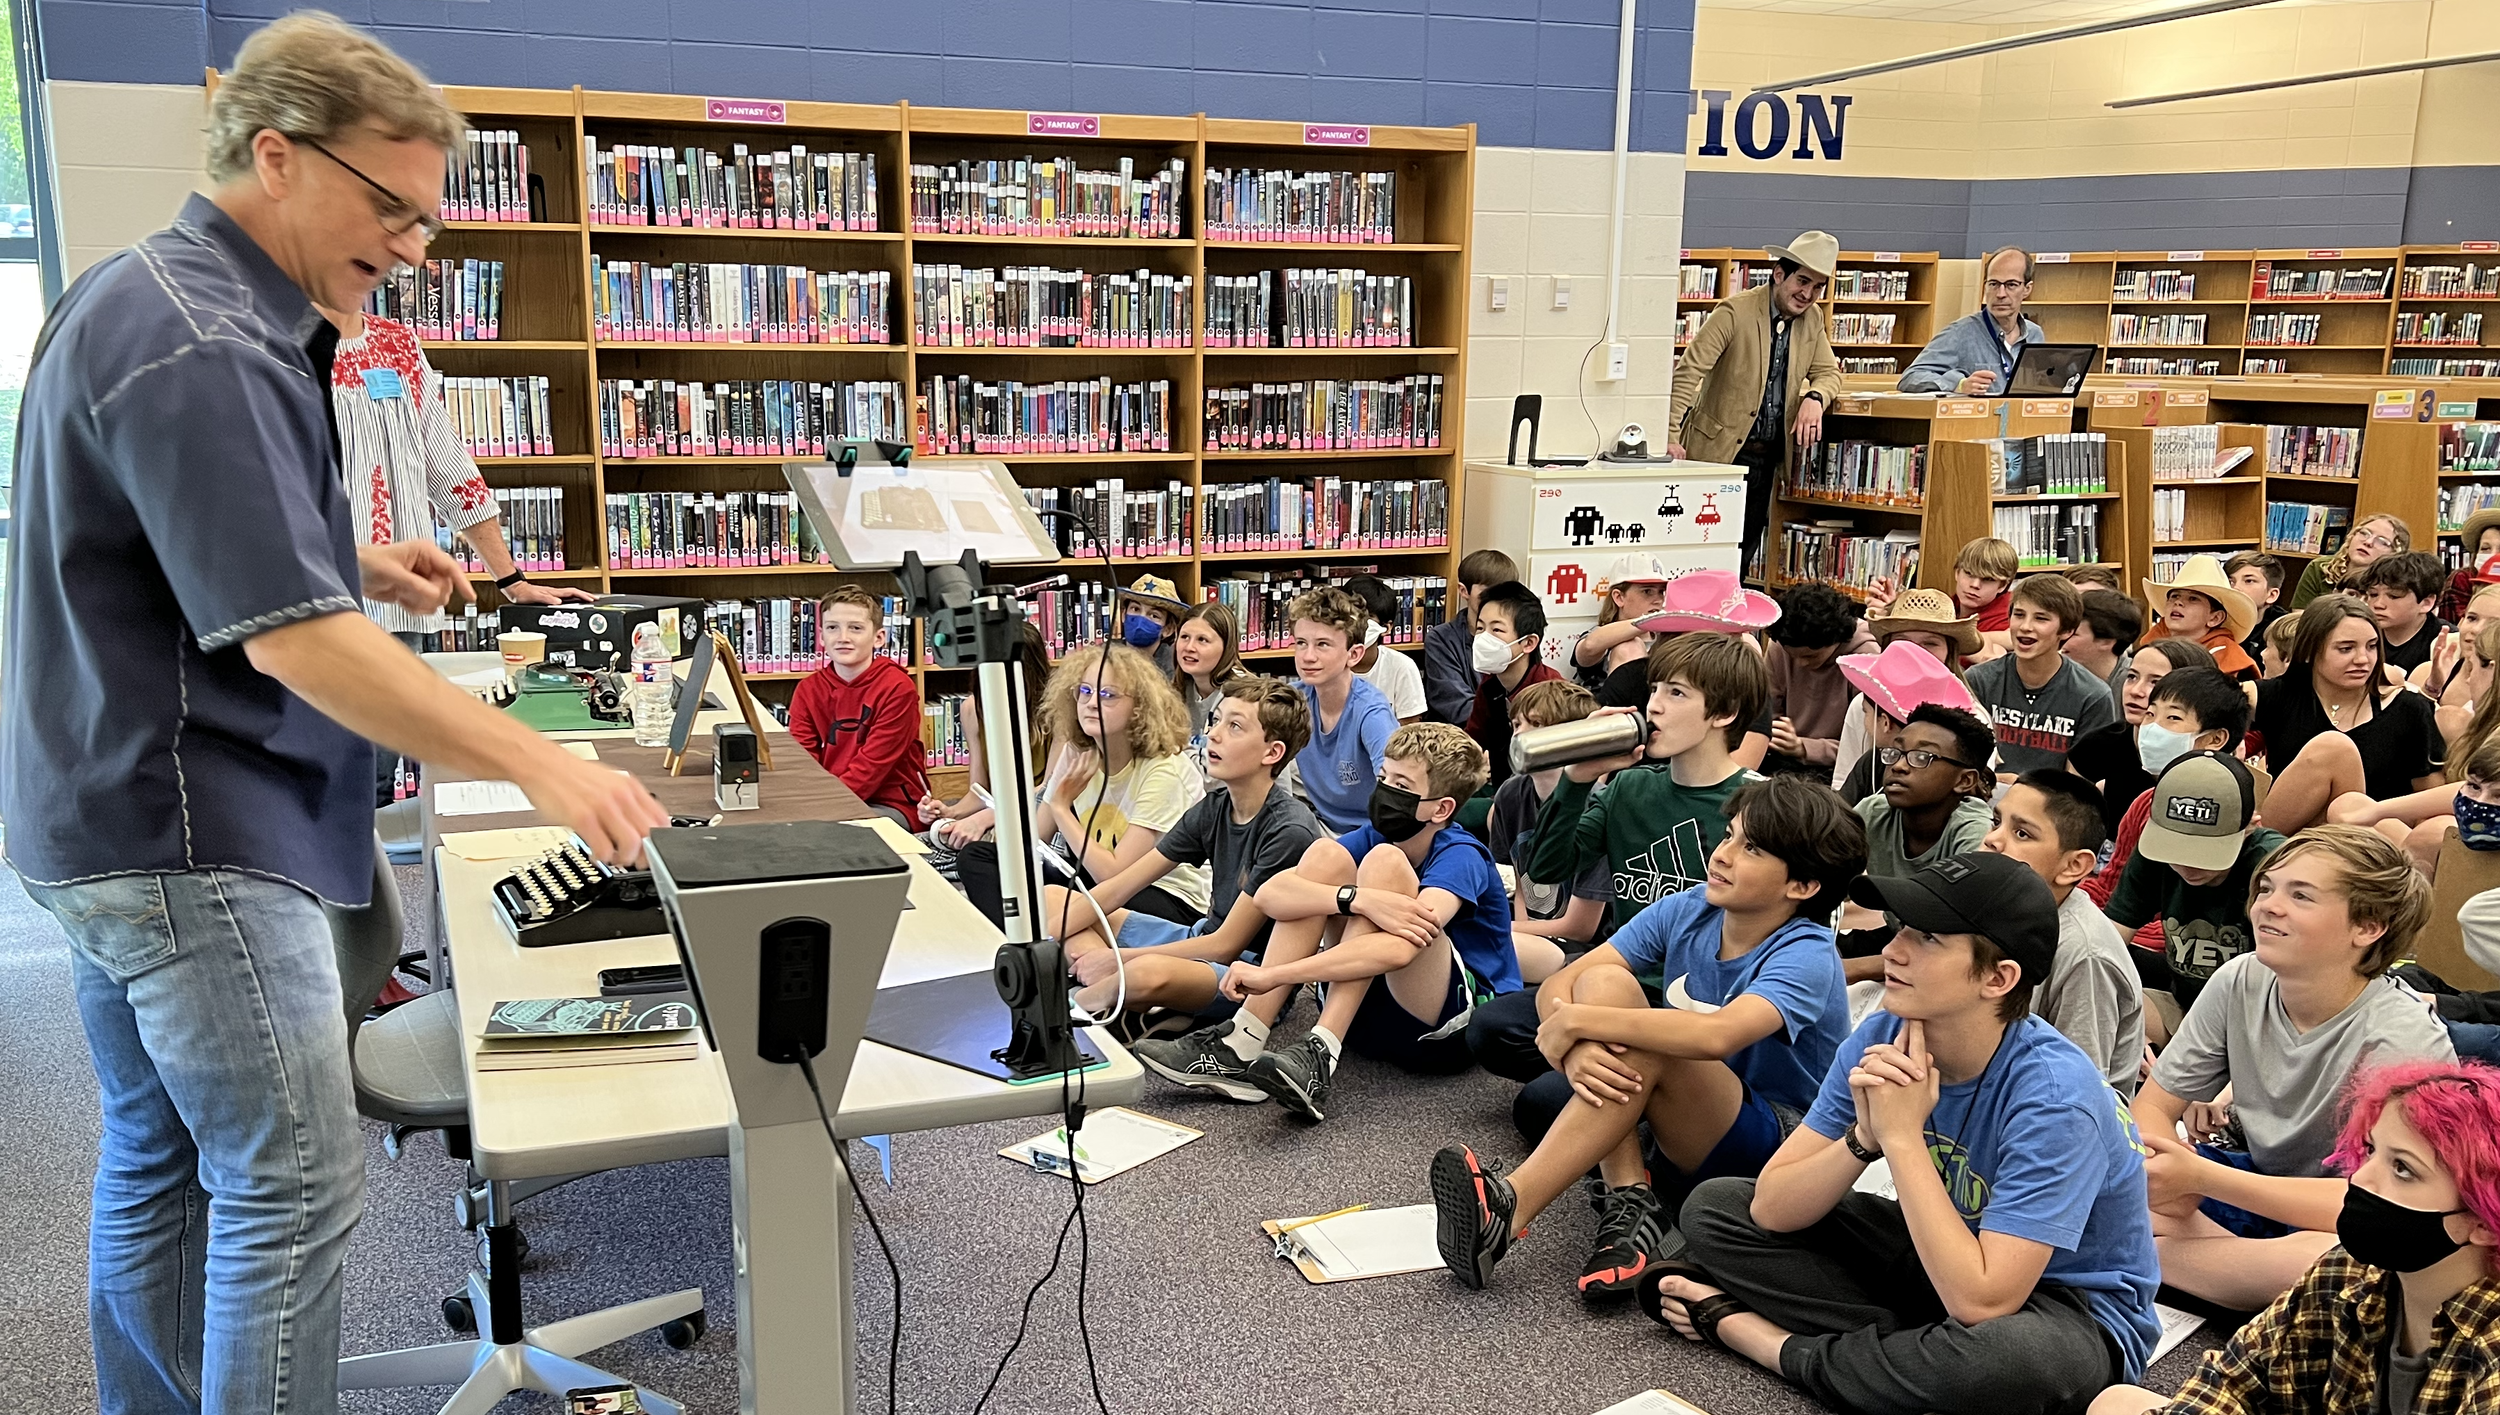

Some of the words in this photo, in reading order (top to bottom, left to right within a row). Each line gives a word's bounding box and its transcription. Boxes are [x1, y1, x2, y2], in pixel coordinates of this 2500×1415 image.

[728, 107, 765, 116] FANTASY
[1047, 121, 1080, 129] FANTASY
[1689, 90, 1852, 160] ION
[1321, 131, 1352, 139] FANTASY
[1994, 401, 2009, 437] 1
[2143, 390, 2161, 425] 2
[2418, 389, 2435, 422] 3
[1539, 488, 1562, 498] 290
[1720, 484, 1742, 493] 290
[1996, 724, 2068, 753] OOTBALL
[2175, 803, 2211, 819] YETI
[1612, 872, 1694, 904] adid
[2171, 935, 2238, 967] YET
